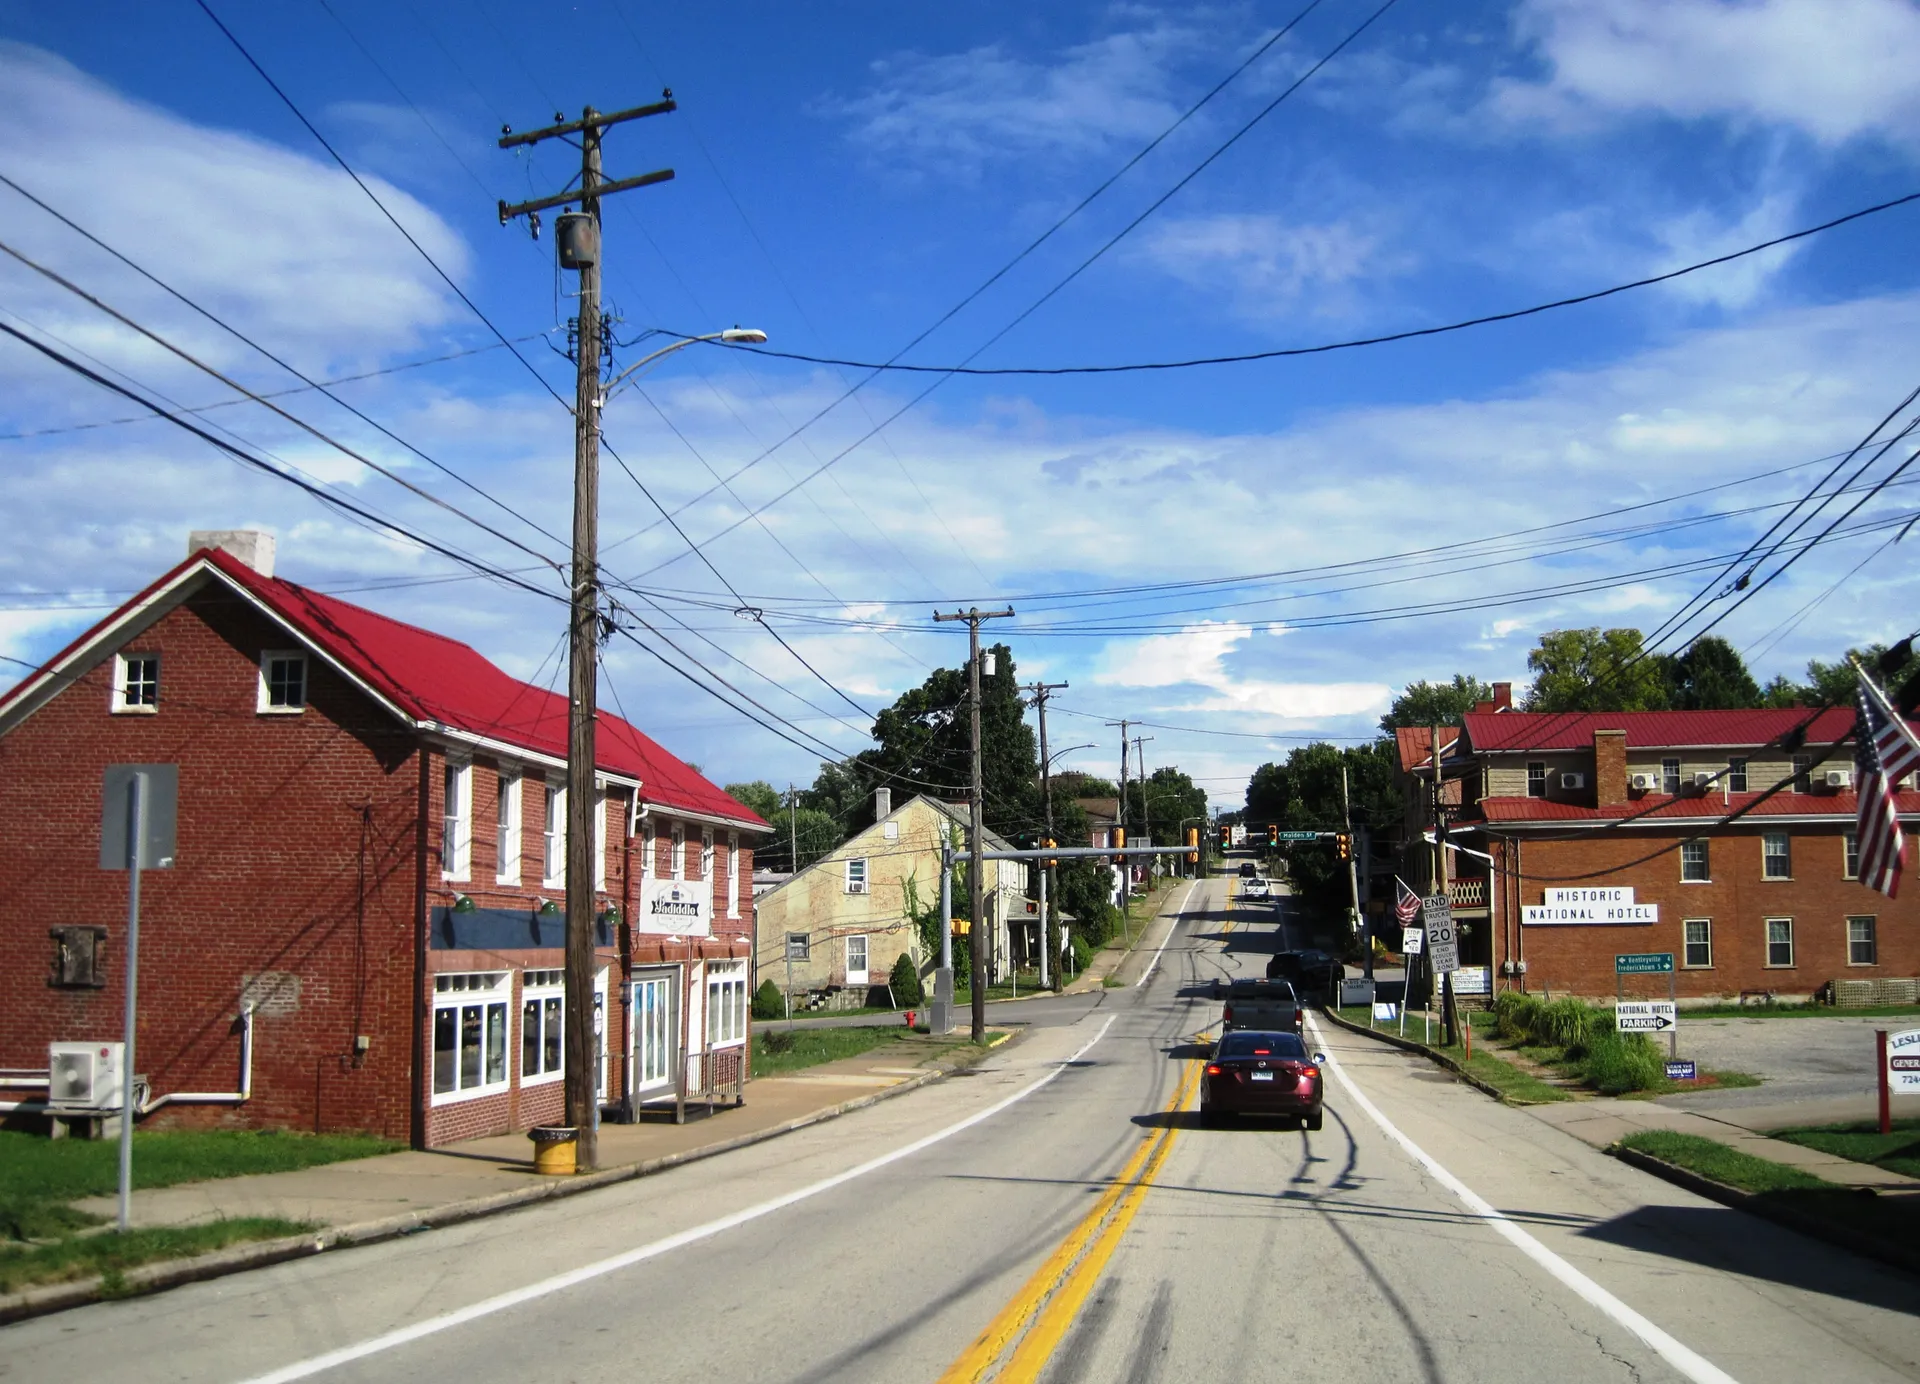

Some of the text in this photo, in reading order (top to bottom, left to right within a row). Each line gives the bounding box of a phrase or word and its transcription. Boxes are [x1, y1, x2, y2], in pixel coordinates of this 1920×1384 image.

[1557, 890, 1621, 902] HISTORIC
[1424, 897, 1446, 909] END
[1425, 911, 1450, 920] TRUCKS
[1530, 908, 1651, 920] NATIONAL HOTEL
[1428, 920, 1449, 929] SPEED
[1429, 928, 1451, 943] 20
[1432, 952, 1455, 960] REDUCED
[1618, 1005, 1673, 1015] NATIONAL HOTEL
[1622, 1018, 1664, 1028] PARKING
[1893, 1059, 1920, 1068] GENER
